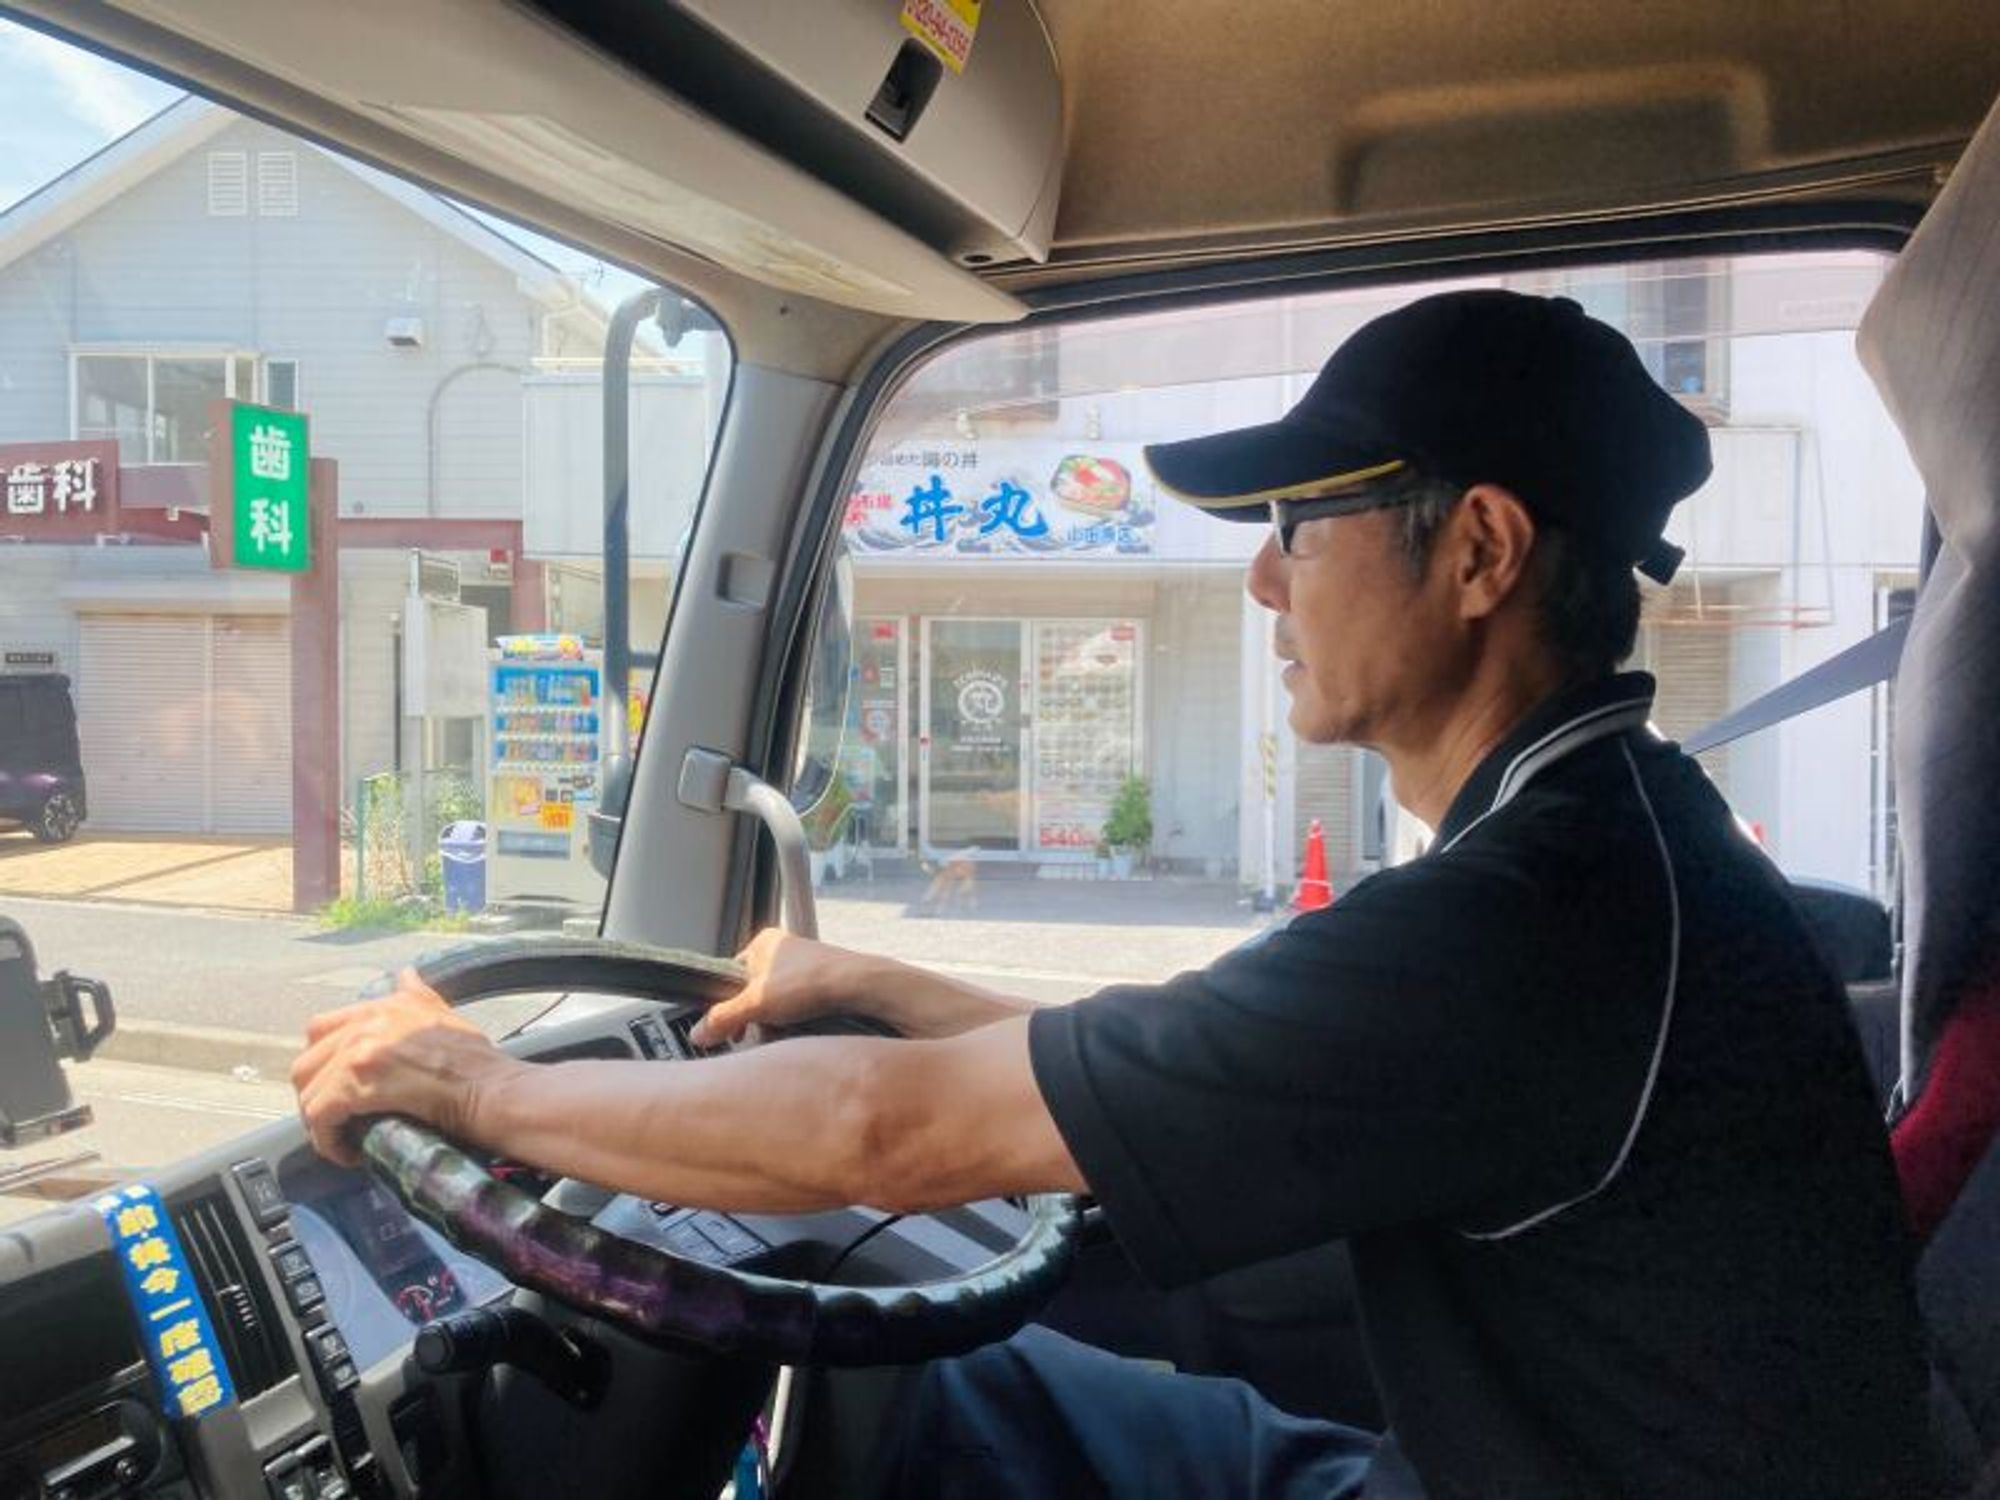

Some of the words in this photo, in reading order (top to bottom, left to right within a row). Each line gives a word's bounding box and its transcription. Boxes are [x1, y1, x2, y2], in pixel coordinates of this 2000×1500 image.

[0, 458, 99, 514] 歯科
[249, 424, 293, 555] 歯科
[899, 474, 1049, 542] 丼丸
